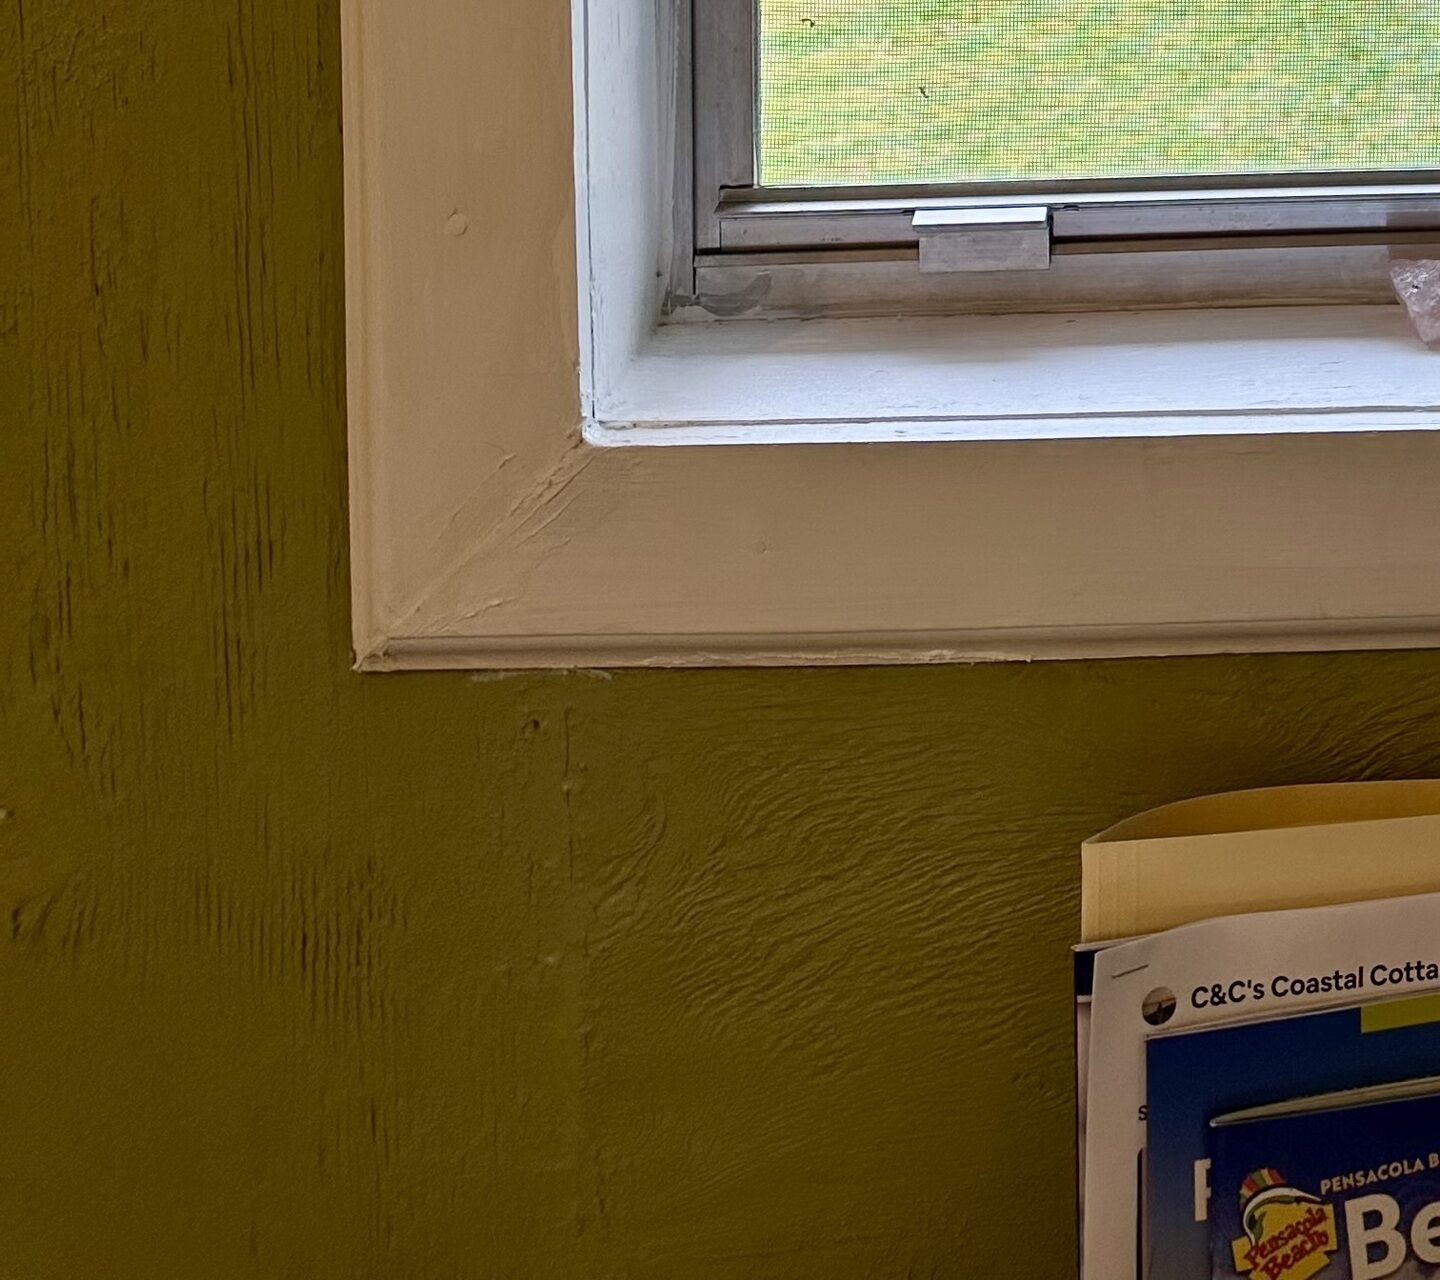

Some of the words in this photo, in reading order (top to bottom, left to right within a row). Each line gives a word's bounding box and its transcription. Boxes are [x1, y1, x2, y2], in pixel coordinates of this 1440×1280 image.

[1191, 979, 1265, 1008] C&C's
[1271, 966, 1364, 997] Coastal
[1320, 1158, 1424, 1195] PENSACOLA
[1243, 1207, 1327, 1270] Pensacola
[1260, 1230, 1329, 1280] Beach
